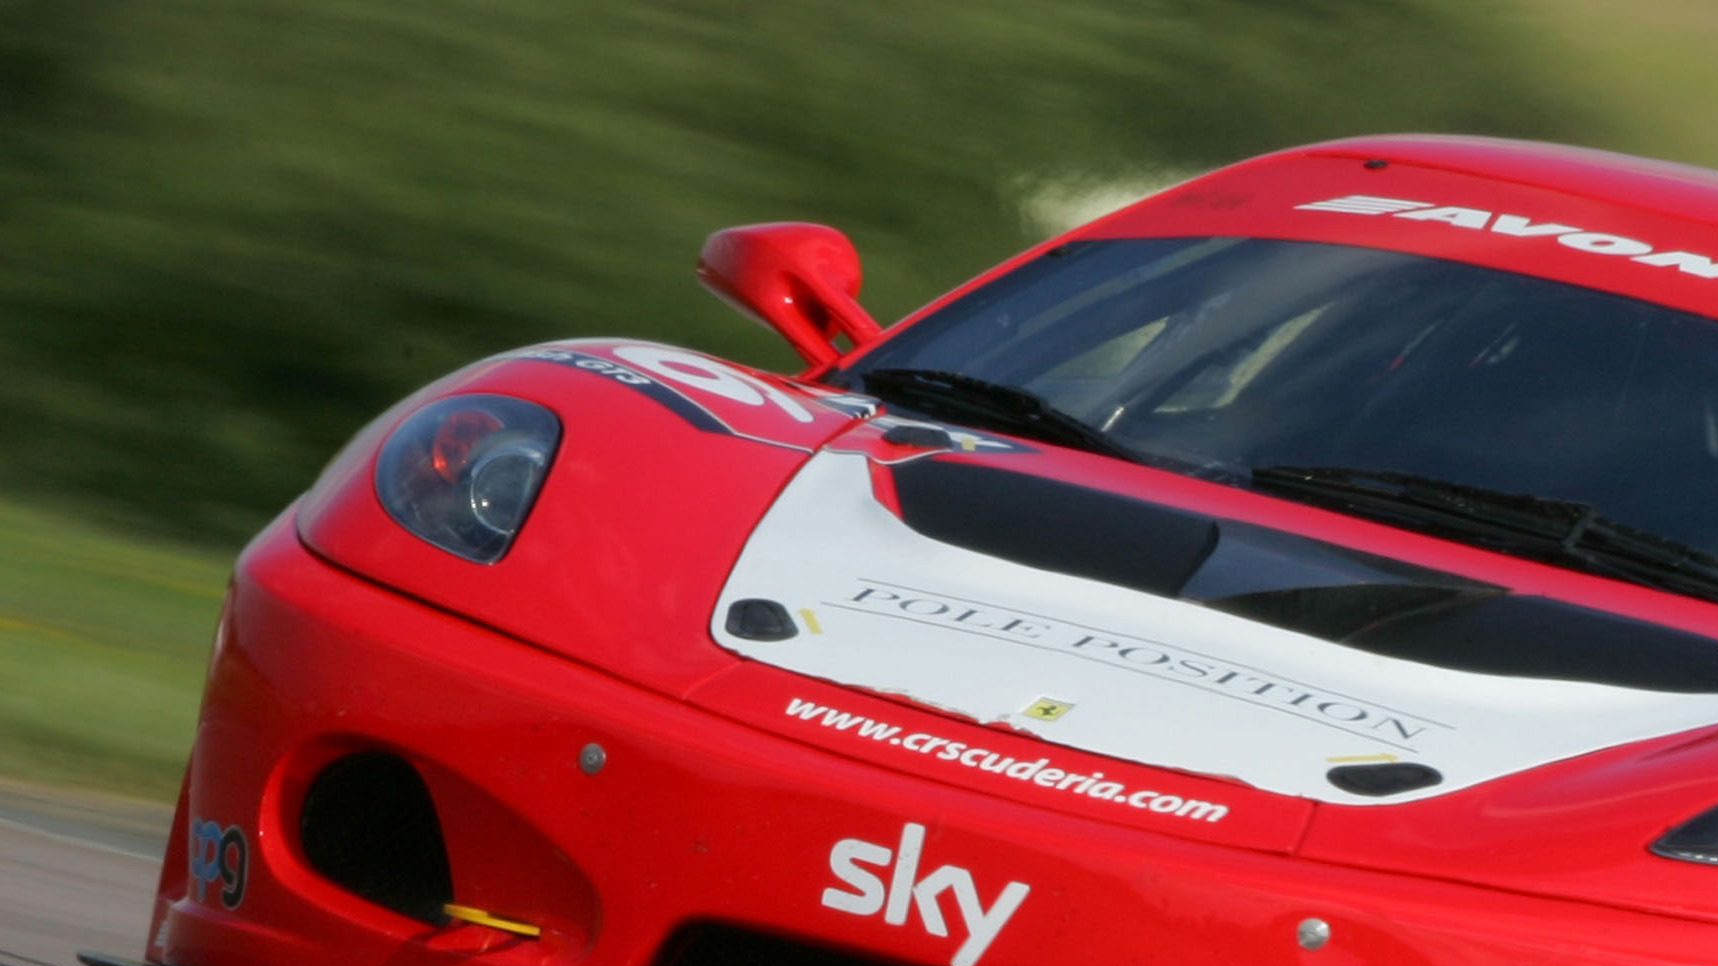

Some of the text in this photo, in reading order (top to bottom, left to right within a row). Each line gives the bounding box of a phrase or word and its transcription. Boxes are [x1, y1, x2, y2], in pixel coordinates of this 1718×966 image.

[850, 587, 1428, 741] POLE POSITION
[784, 696, 1230, 823] www.crscuderia.com
